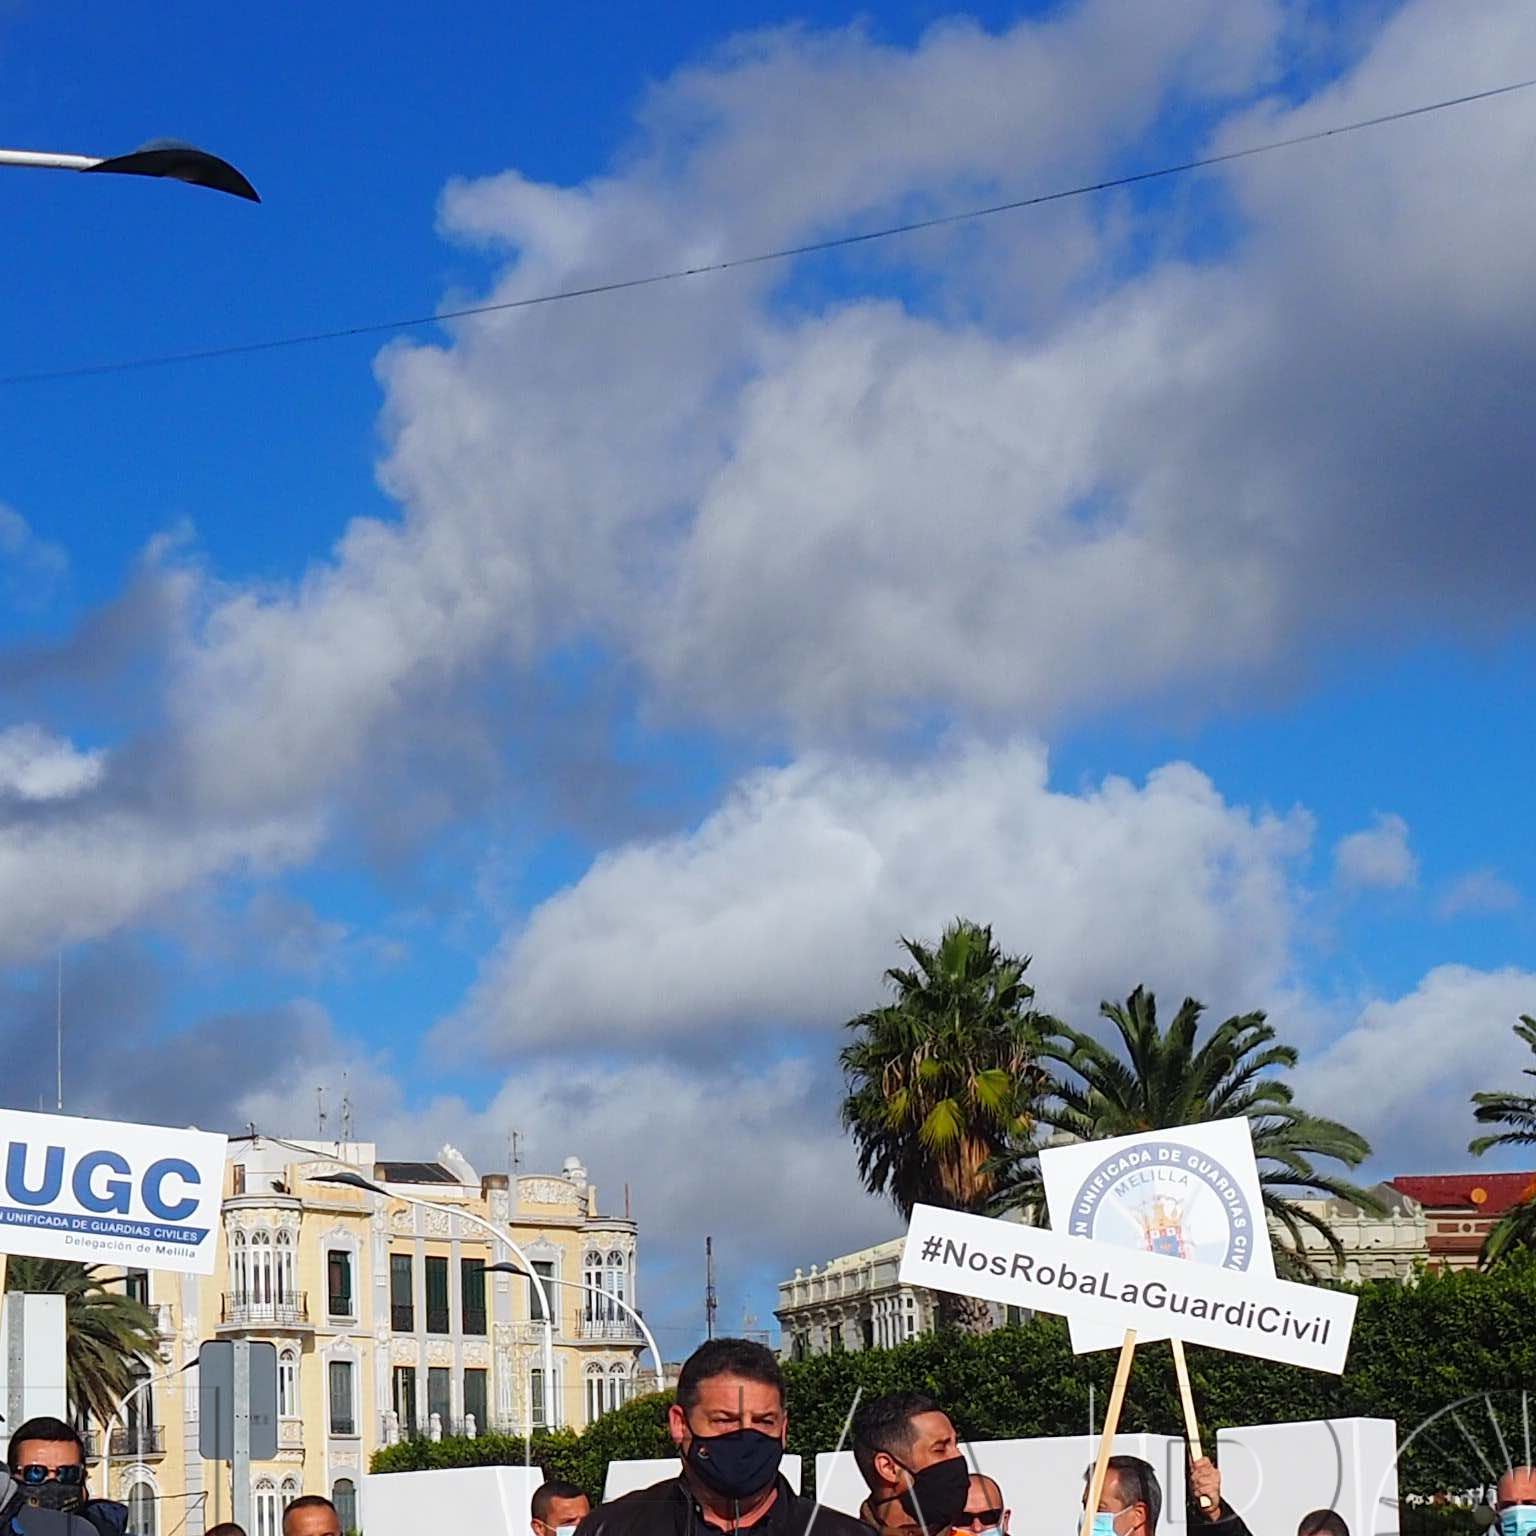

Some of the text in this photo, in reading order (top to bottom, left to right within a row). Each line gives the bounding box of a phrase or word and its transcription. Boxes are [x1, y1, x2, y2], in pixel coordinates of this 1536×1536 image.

[1078, 1148, 1247, 1229] UNIFICADA DE GUARDIAS
[1114, 1168, 1190, 1197] MELILLA
[6, 1211, 69, 1230] UNIFICADA
[72, 1218, 88, 1231] DE
[90, 1219, 152, 1240] GUARDIAS
[153, 1227, 199, 1243] CIVILES
[64, 1235, 196, 1259] Delegación de Melilla
[920, 1234, 1333, 1346] #NosRobaLaGuardiCivil
